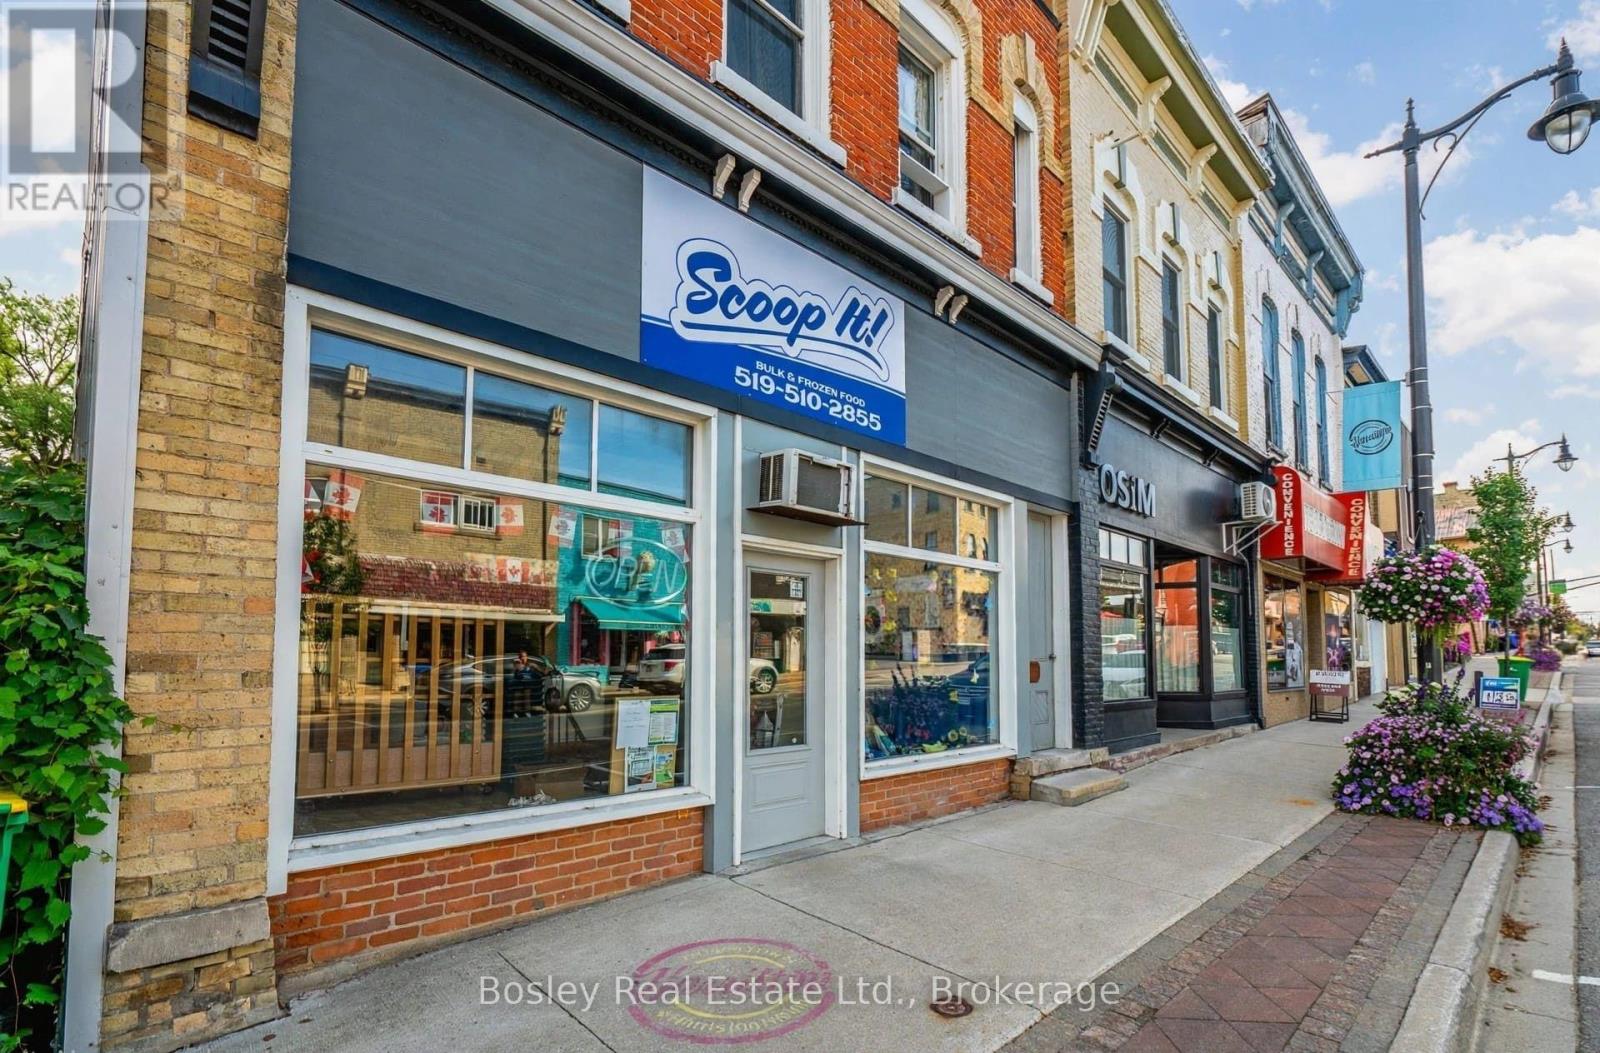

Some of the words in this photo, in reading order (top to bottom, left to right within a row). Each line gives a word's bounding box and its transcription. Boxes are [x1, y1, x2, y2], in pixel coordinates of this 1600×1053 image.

[686, 250, 827, 347] Scoop
[834, 296, 889, 348] It!
[735, 366, 882, 431] 519-510-2855
[755, 360, 788, 380] BULK
[787, 371, 796, 382] &
[798, 375, 838, 399] FROZEN
[839, 388, 866, 409] FOOD
[1282, 473, 1295, 556] CONVENIENCE
[1348, 498, 1364, 577] CONVENIENCE
[591, 554, 680, 594] OPEN
